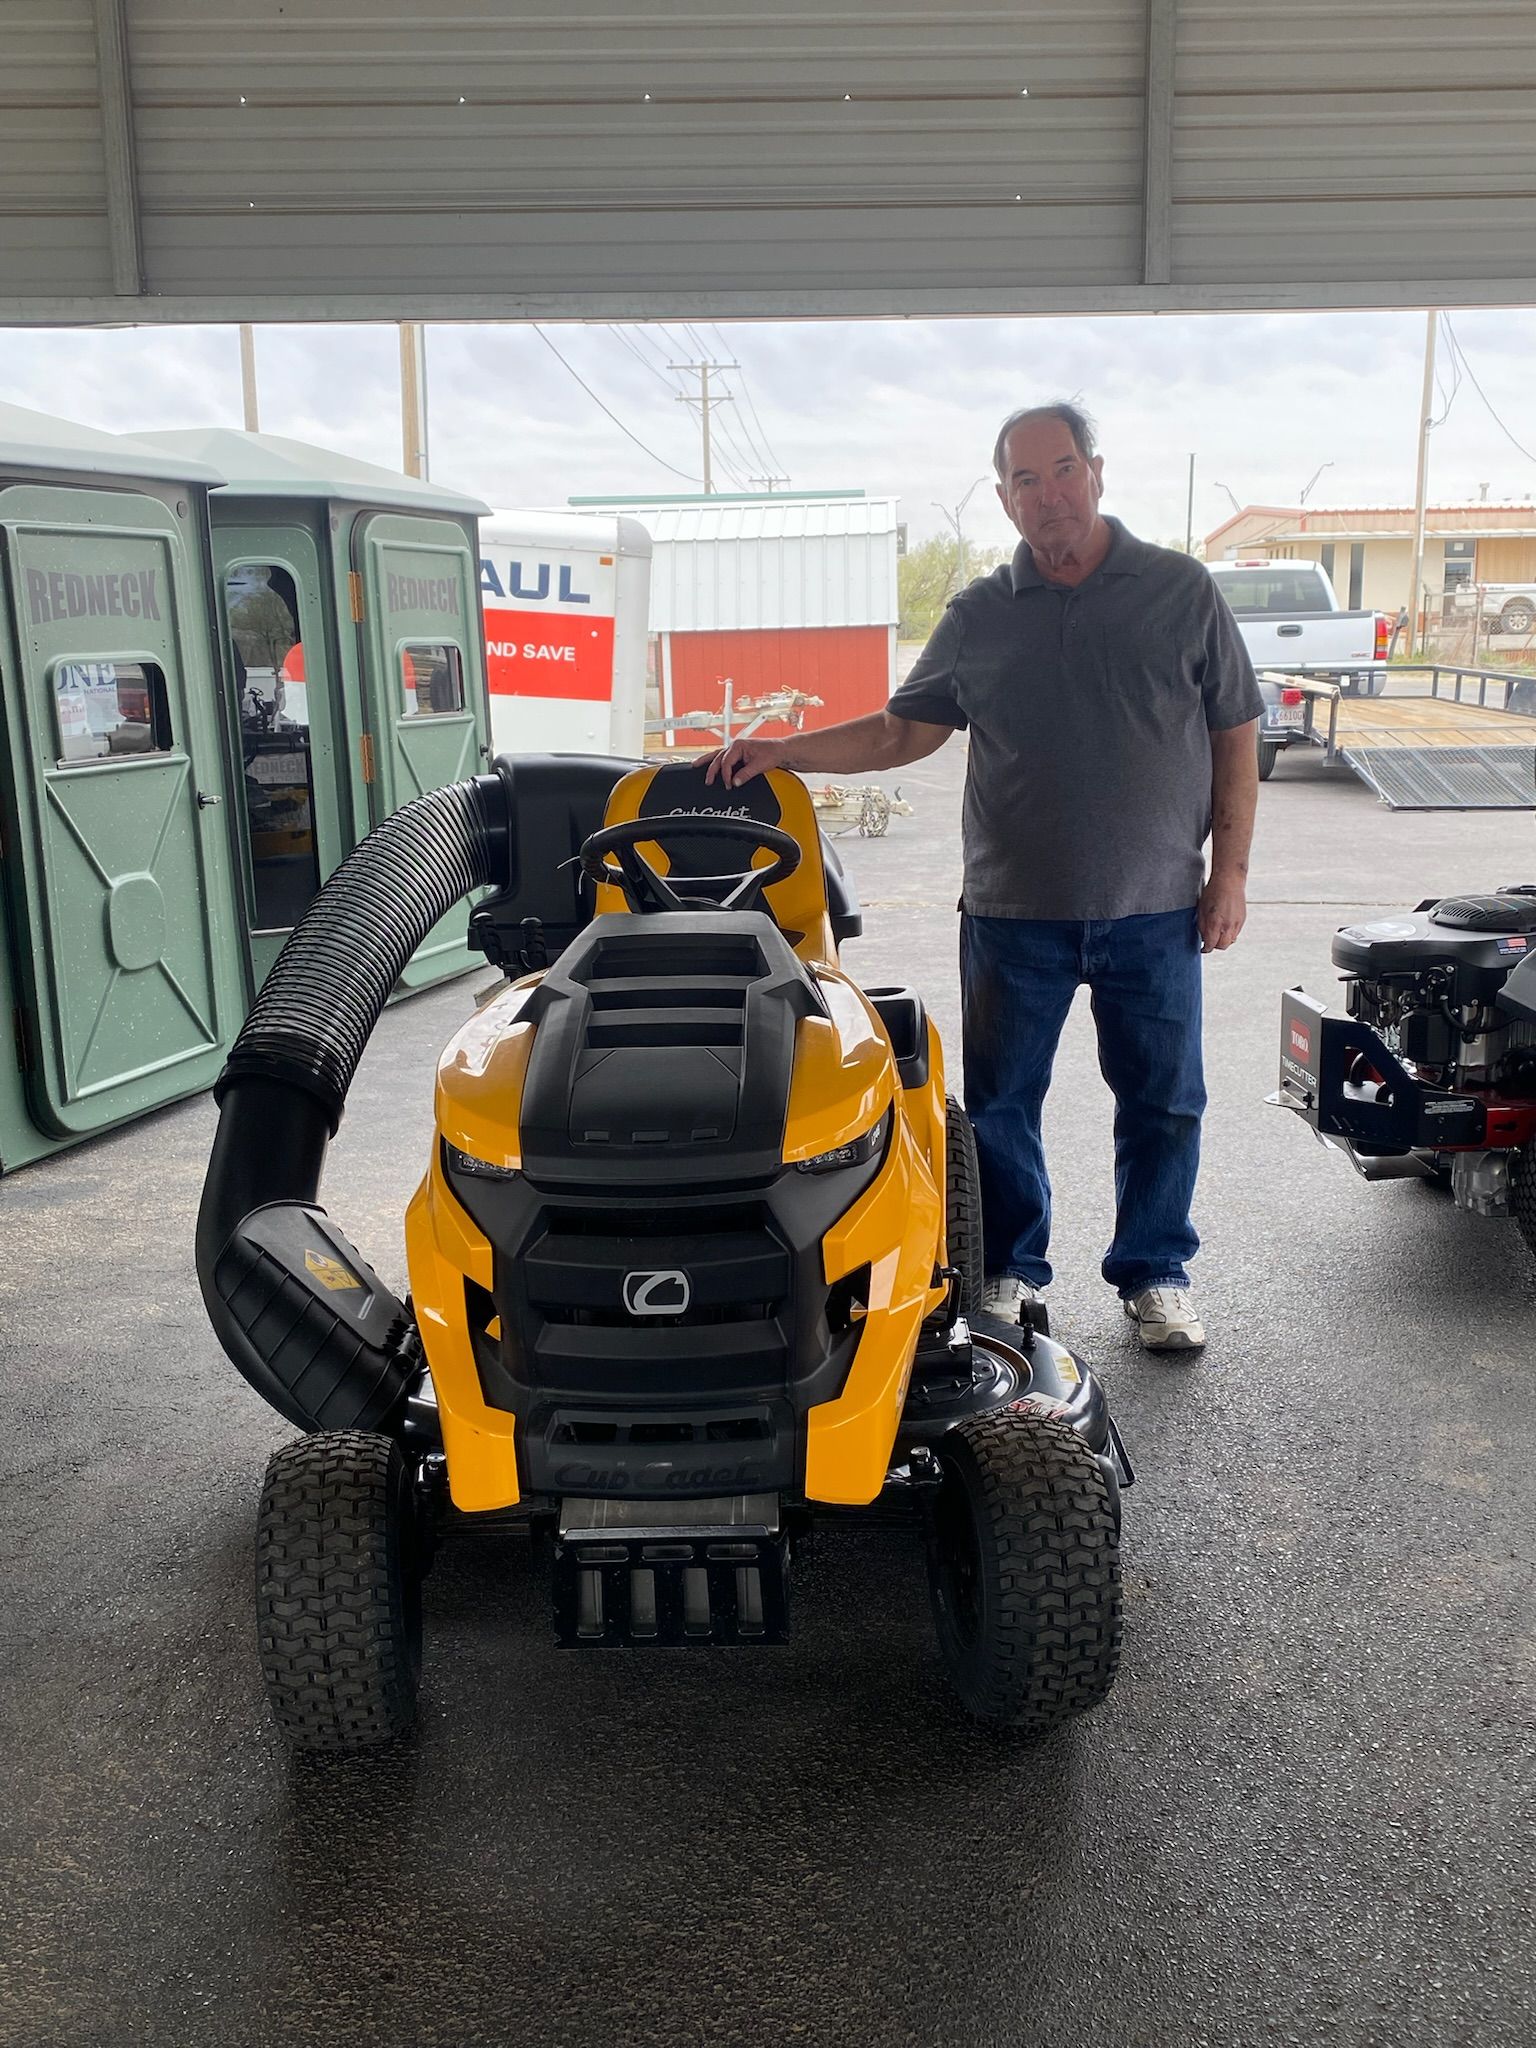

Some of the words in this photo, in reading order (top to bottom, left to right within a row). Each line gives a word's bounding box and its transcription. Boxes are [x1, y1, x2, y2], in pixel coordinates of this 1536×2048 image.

[26, 568, 161, 625] REDNECK
[387, 572, 459, 616] REDNECK
[480, 559, 590, 604] AUL
[487, 641, 517, 657] ND
[522, 643, 576, 662] SAVE
[1291, 1030, 1309, 1053] TORO
[1282, 1055, 1317, 1088] TIMECUTTER
[554, 1461, 629, 1489] Cub
[634, 1457, 764, 1489] Cadet
